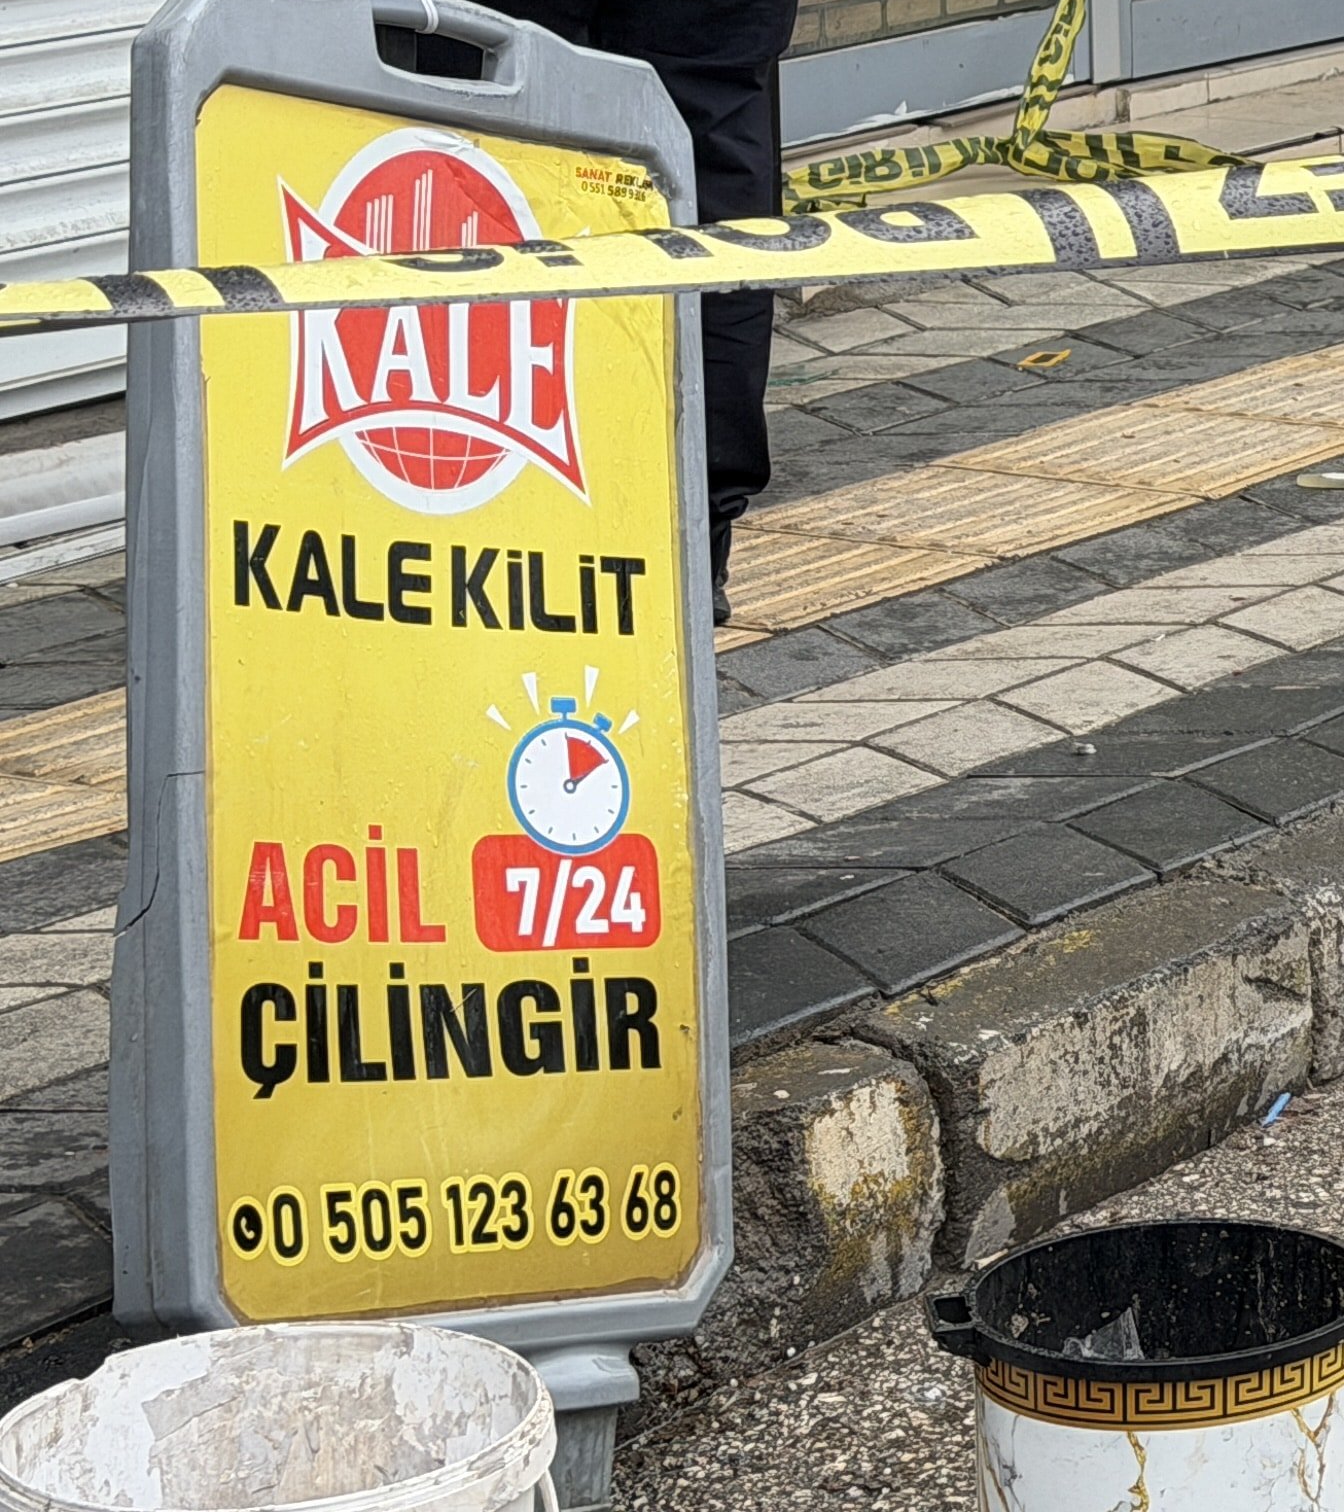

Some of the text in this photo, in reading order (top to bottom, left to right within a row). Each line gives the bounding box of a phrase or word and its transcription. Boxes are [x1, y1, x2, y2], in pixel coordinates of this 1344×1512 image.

[575, 166, 613, 183] SANAT
[298, 233, 582, 465] KALE
[233, 520, 646, 636] KALE KİLİT
[238, 825, 646, 947] ACİL 7/24
[240, 956, 662, 1100] ÇİLİNGİR
[273, 1169, 678, 1259] 0 505 123 63 68
